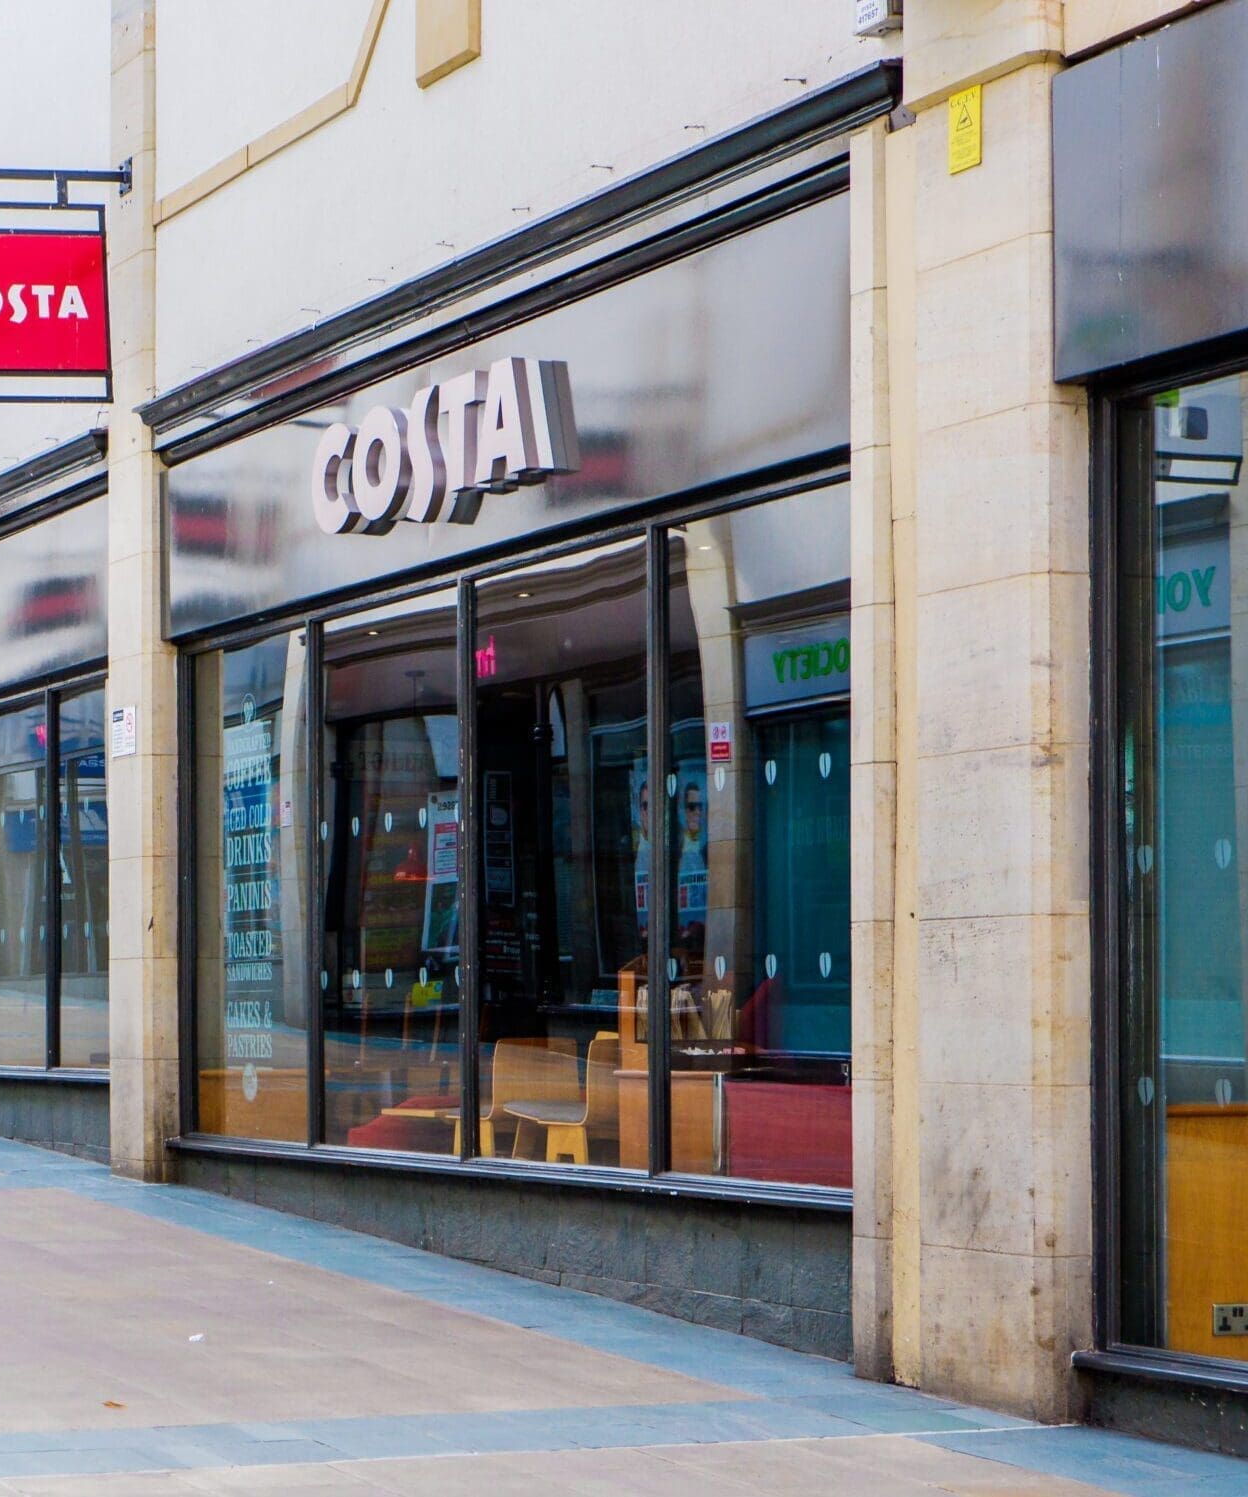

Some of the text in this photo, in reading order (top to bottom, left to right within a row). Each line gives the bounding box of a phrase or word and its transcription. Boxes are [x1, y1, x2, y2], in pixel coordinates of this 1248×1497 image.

[312, 356, 580, 536] COSTA
[226, 754, 272, 791] COFFEE
[248, 803, 271, 829] COLD
[226, 830, 272, 867] DRINKS
[226, 880, 272, 913] PANINIS
[227, 929, 272, 959] TOASTED
[227, 962, 272, 982] SANDWICHES
[226, 1001, 273, 1029] CAKES &
[227, 1034, 273, 1058] PASTRIES
